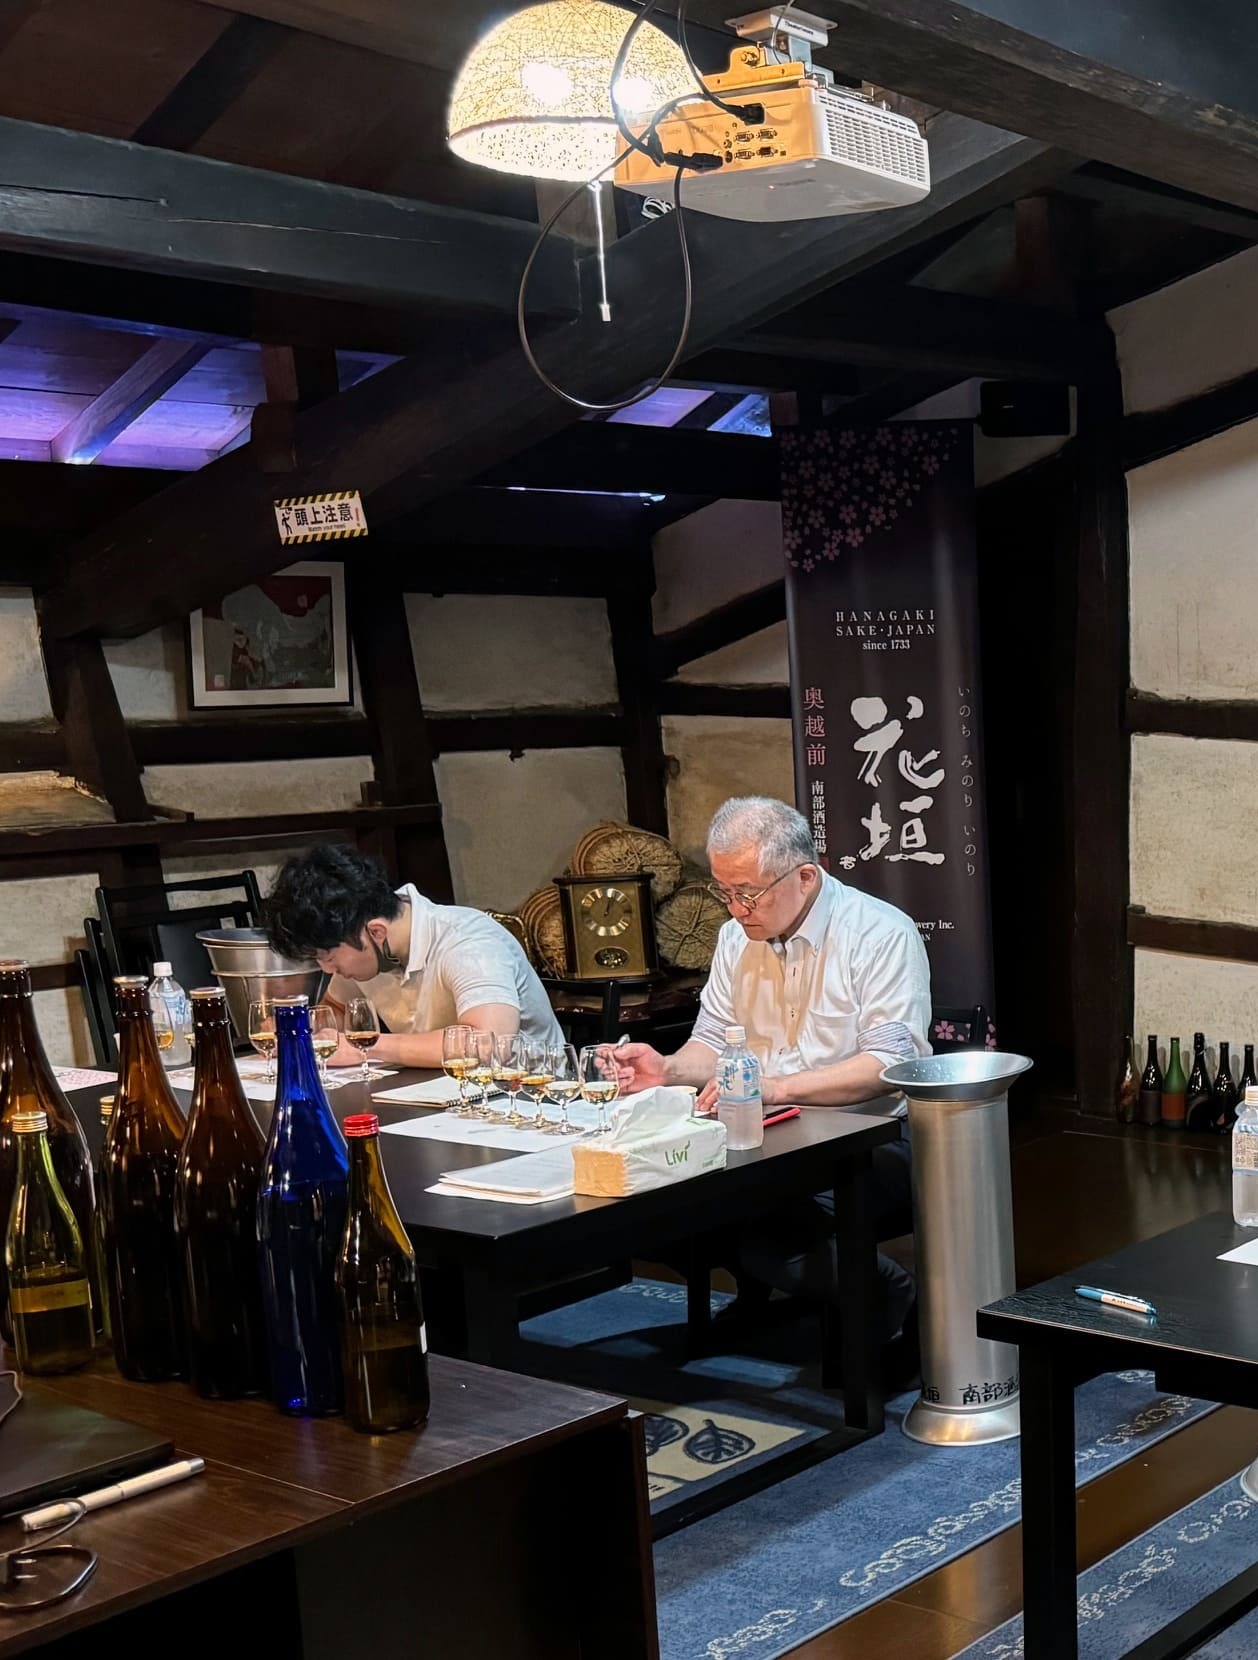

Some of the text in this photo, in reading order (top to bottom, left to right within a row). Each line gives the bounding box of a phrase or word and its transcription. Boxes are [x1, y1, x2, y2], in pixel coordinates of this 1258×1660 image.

[835, 609, 935, 623] HANAGAKI
[862, 639, 910, 650] since 1733
[803, 686, 827, 768] 奥越前
[850, 695, 946, 865] 花垣
[957, 686, 976, 876] いのち みのり いのり
[811, 780, 826, 854] 南部酒造場
[939, 919, 955, 929] Inc.
[665, 1140, 690, 1166] Livi
